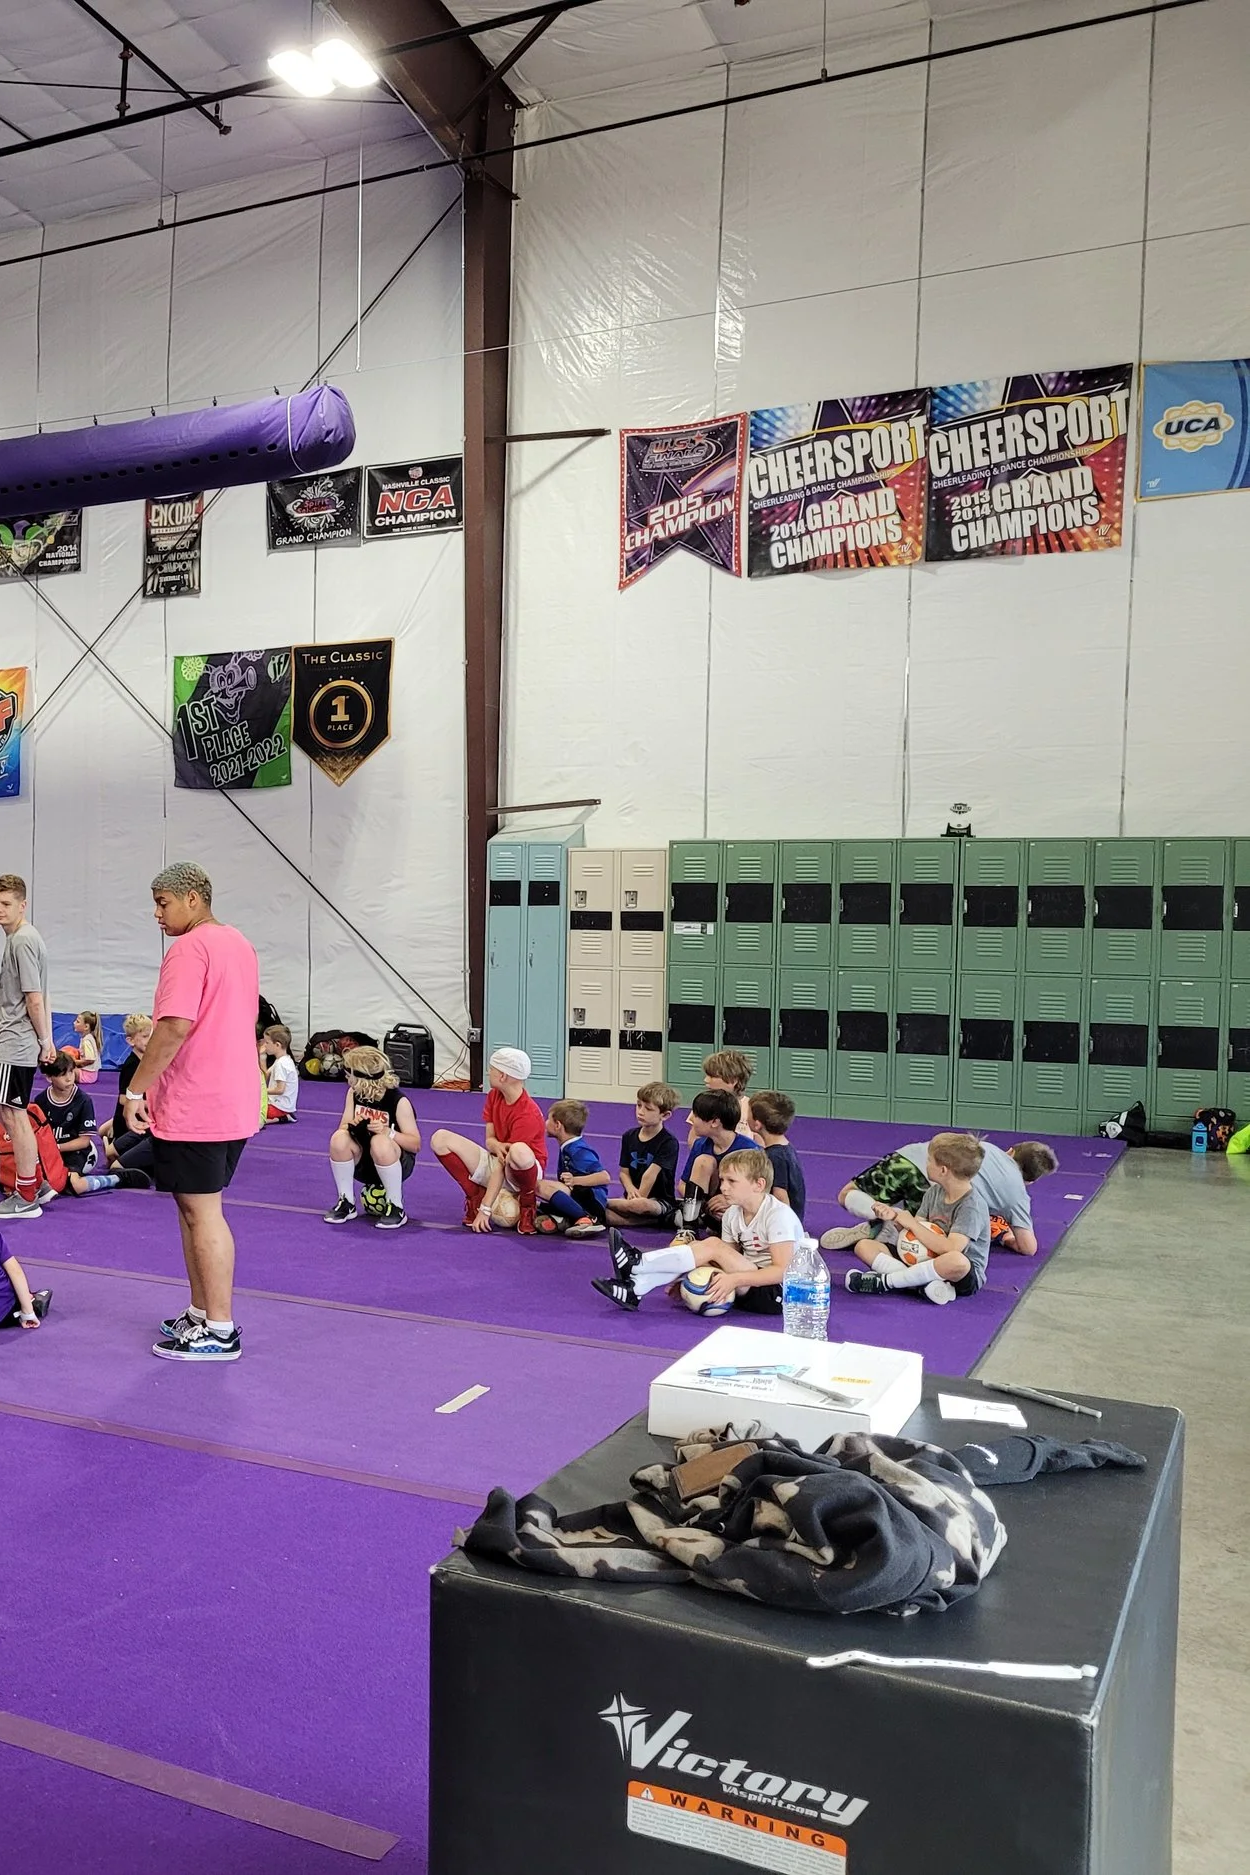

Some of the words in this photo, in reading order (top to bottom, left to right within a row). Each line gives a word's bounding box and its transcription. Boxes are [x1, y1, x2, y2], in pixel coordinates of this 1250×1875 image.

[929, 389, 1129, 478] CHEERSPORT
[1164, 417, 1221, 435] UCA
[749, 415, 928, 499] CHEERSPORT
[932, 470, 991, 490] CHEERLEADING
[992, 466, 999, 476] &
[1000, 460, 1027, 475] DANCE
[1027, 447, 1095, 467] CHAMPIONSHIPS
[376, 484, 455, 516] NCA
[382, 480, 420, 490] NASHVILLE
[420, 476, 451, 486] CLASSIC
[753, 490, 805, 510] CHEERLEADING
[812, 480, 836, 495] DANCE
[836, 469, 897, 489] CHAMPIONSHIPS
[950, 489, 991, 510] 2013
[992, 465, 1095, 513] GRAND
[149, 500, 199, 527] ENCORE
[374, 508, 457, 527] CHAMPION
[623, 497, 736, 551] CHAMPION
[649, 490, 703, 525] 2015
[805, 487, 897, 532] GRAND
[951, 496, 1100, 553] CHAMPIONS
[952, 504, 991, 523] 2014
[56, 544, 78, 554] 2014
[275, 534, 305, 546] GRAND
[306, 527, 353, 542] CHAMPION
[769, 520, 806, 543] 2014
[769, 516, 903, 569] CHAMPIONS
[45, 551, 78, 559] NATIONAL
[177, 696, 220, 762] 1ST
[201, 720, 251, 763] PLACE
[209, 733, 288, 788] 2021-2022
[631, 1710, 870, 1826] Victory
[669, 1792, 826, 1847] WARNING
[722, 1783, 819, 1820] VAspirit.com
